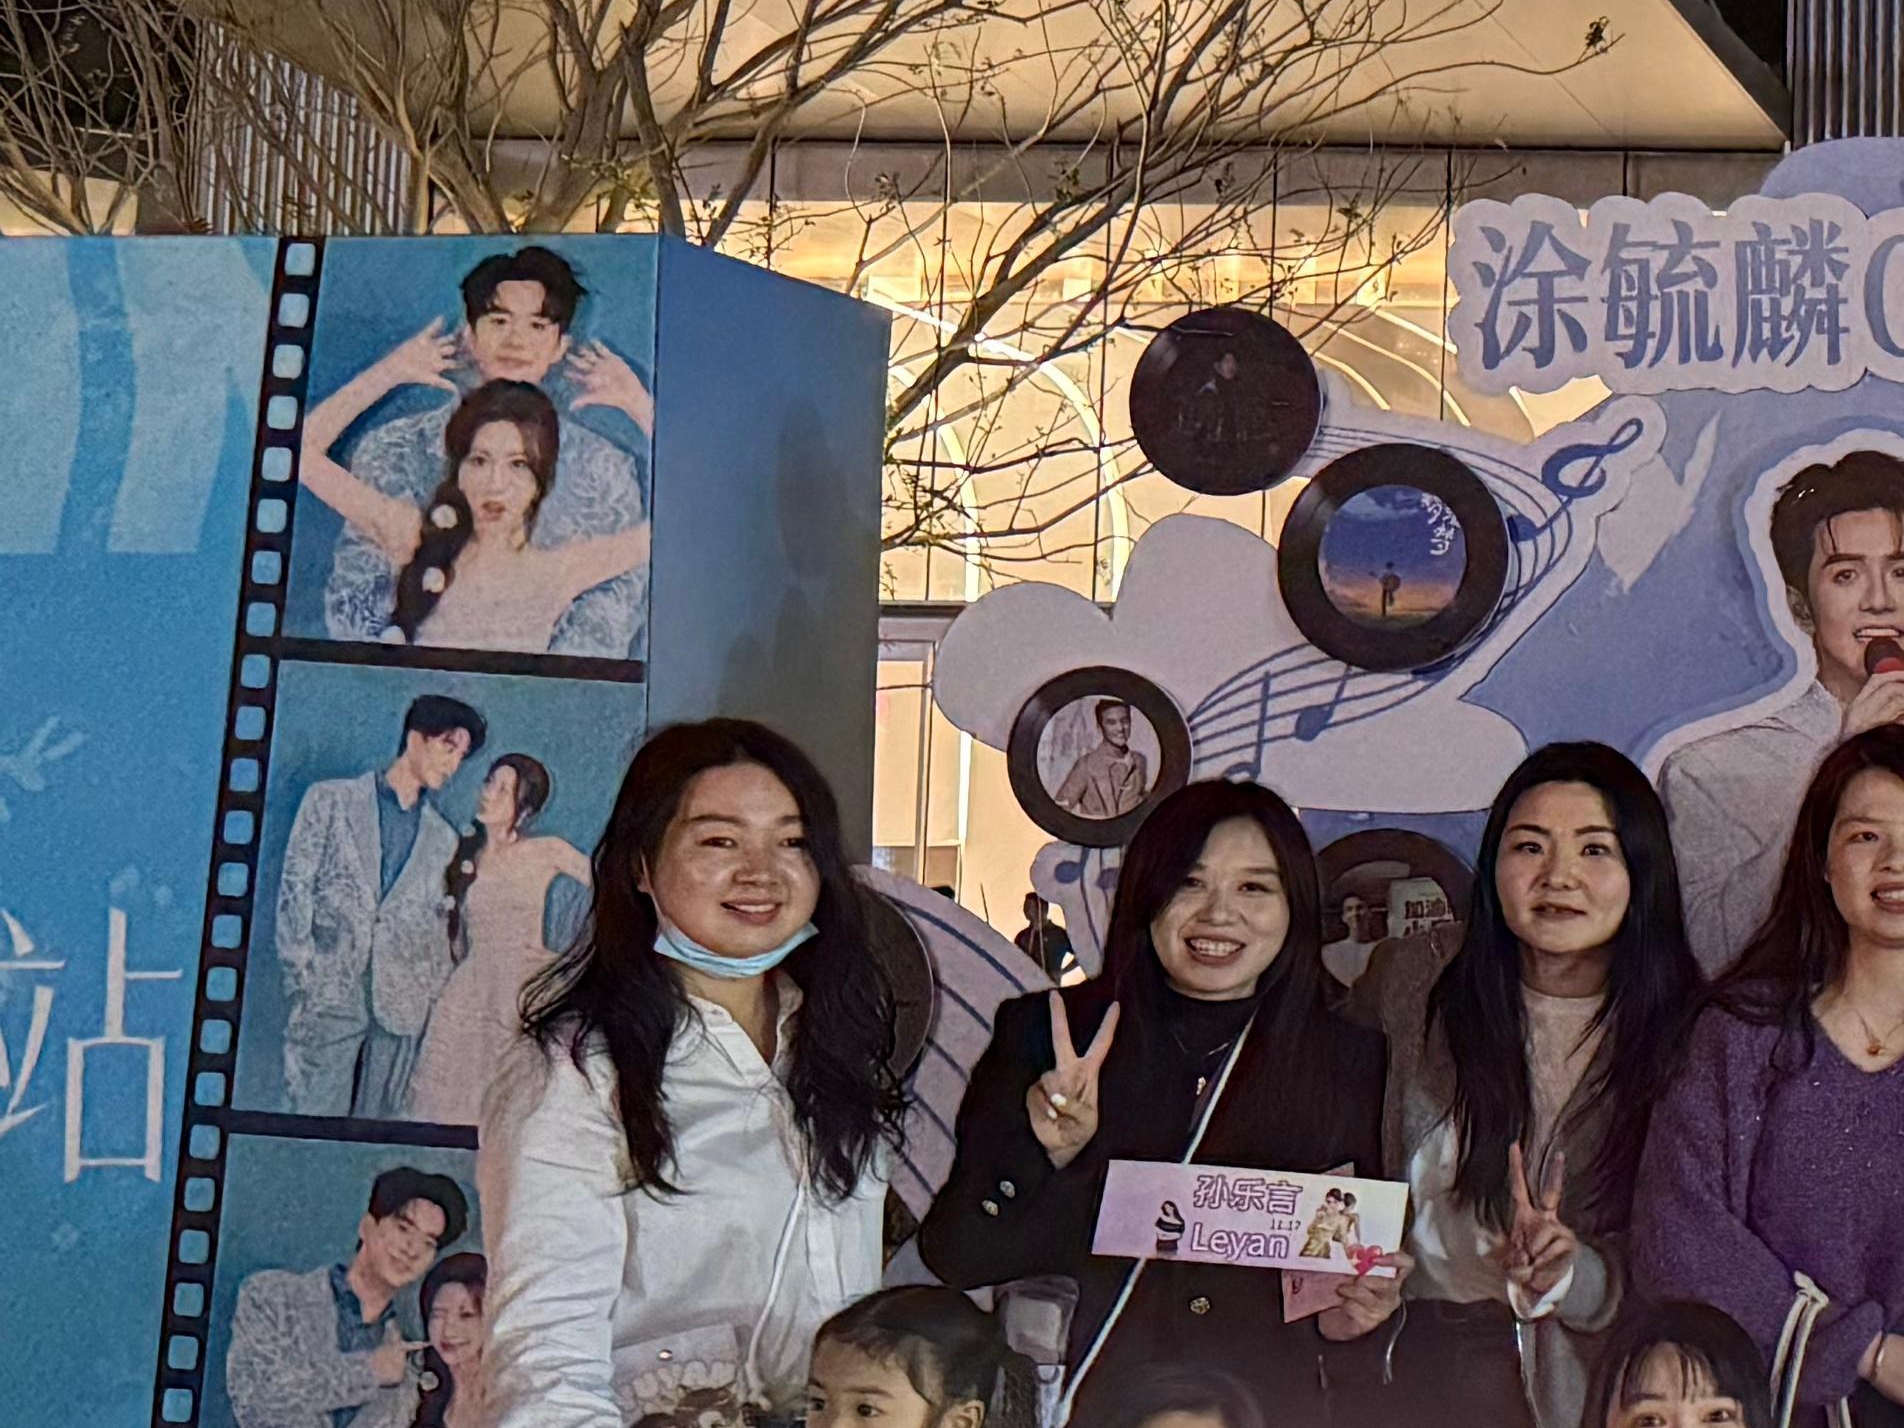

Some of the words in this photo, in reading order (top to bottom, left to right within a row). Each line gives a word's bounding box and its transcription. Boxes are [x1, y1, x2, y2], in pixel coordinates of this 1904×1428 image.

[1193, 1174, 1303, 1215] 孙乐言
[1190, 1221, 1290, 1260] Leyan
